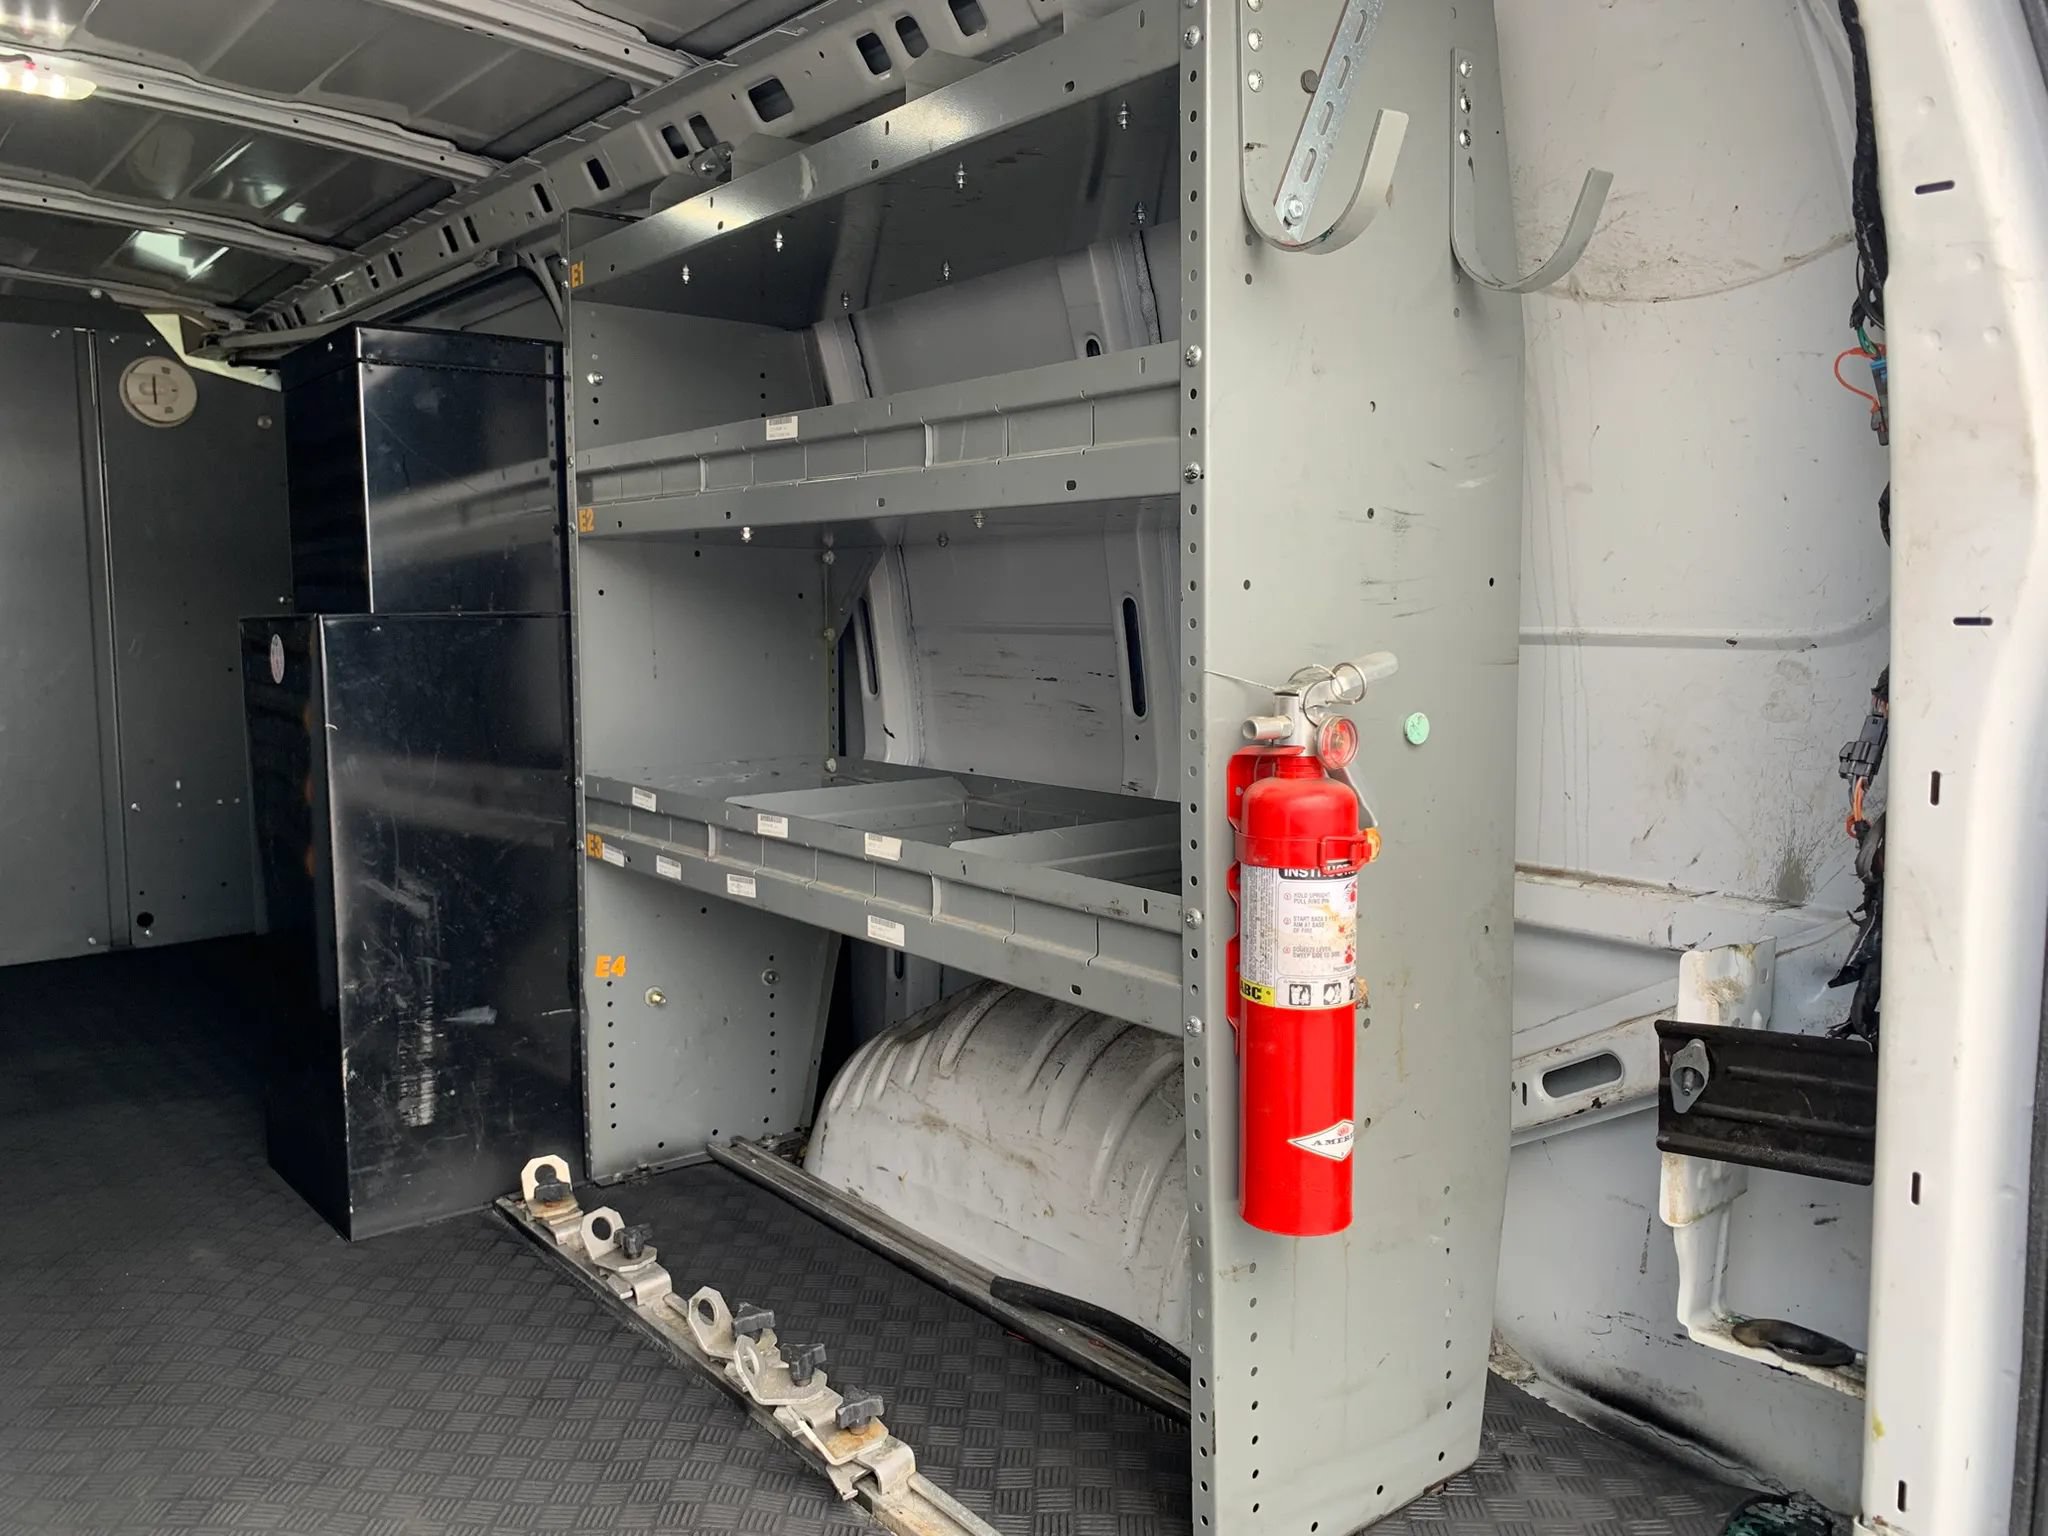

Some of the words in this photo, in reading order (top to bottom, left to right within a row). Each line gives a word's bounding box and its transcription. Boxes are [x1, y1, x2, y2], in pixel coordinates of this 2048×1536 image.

[571, 260, 584, 289] E1
[578, 508, 594, 533] E2
[586, 832, 603, 859] E3
[594, 954, 626, 977] E4
